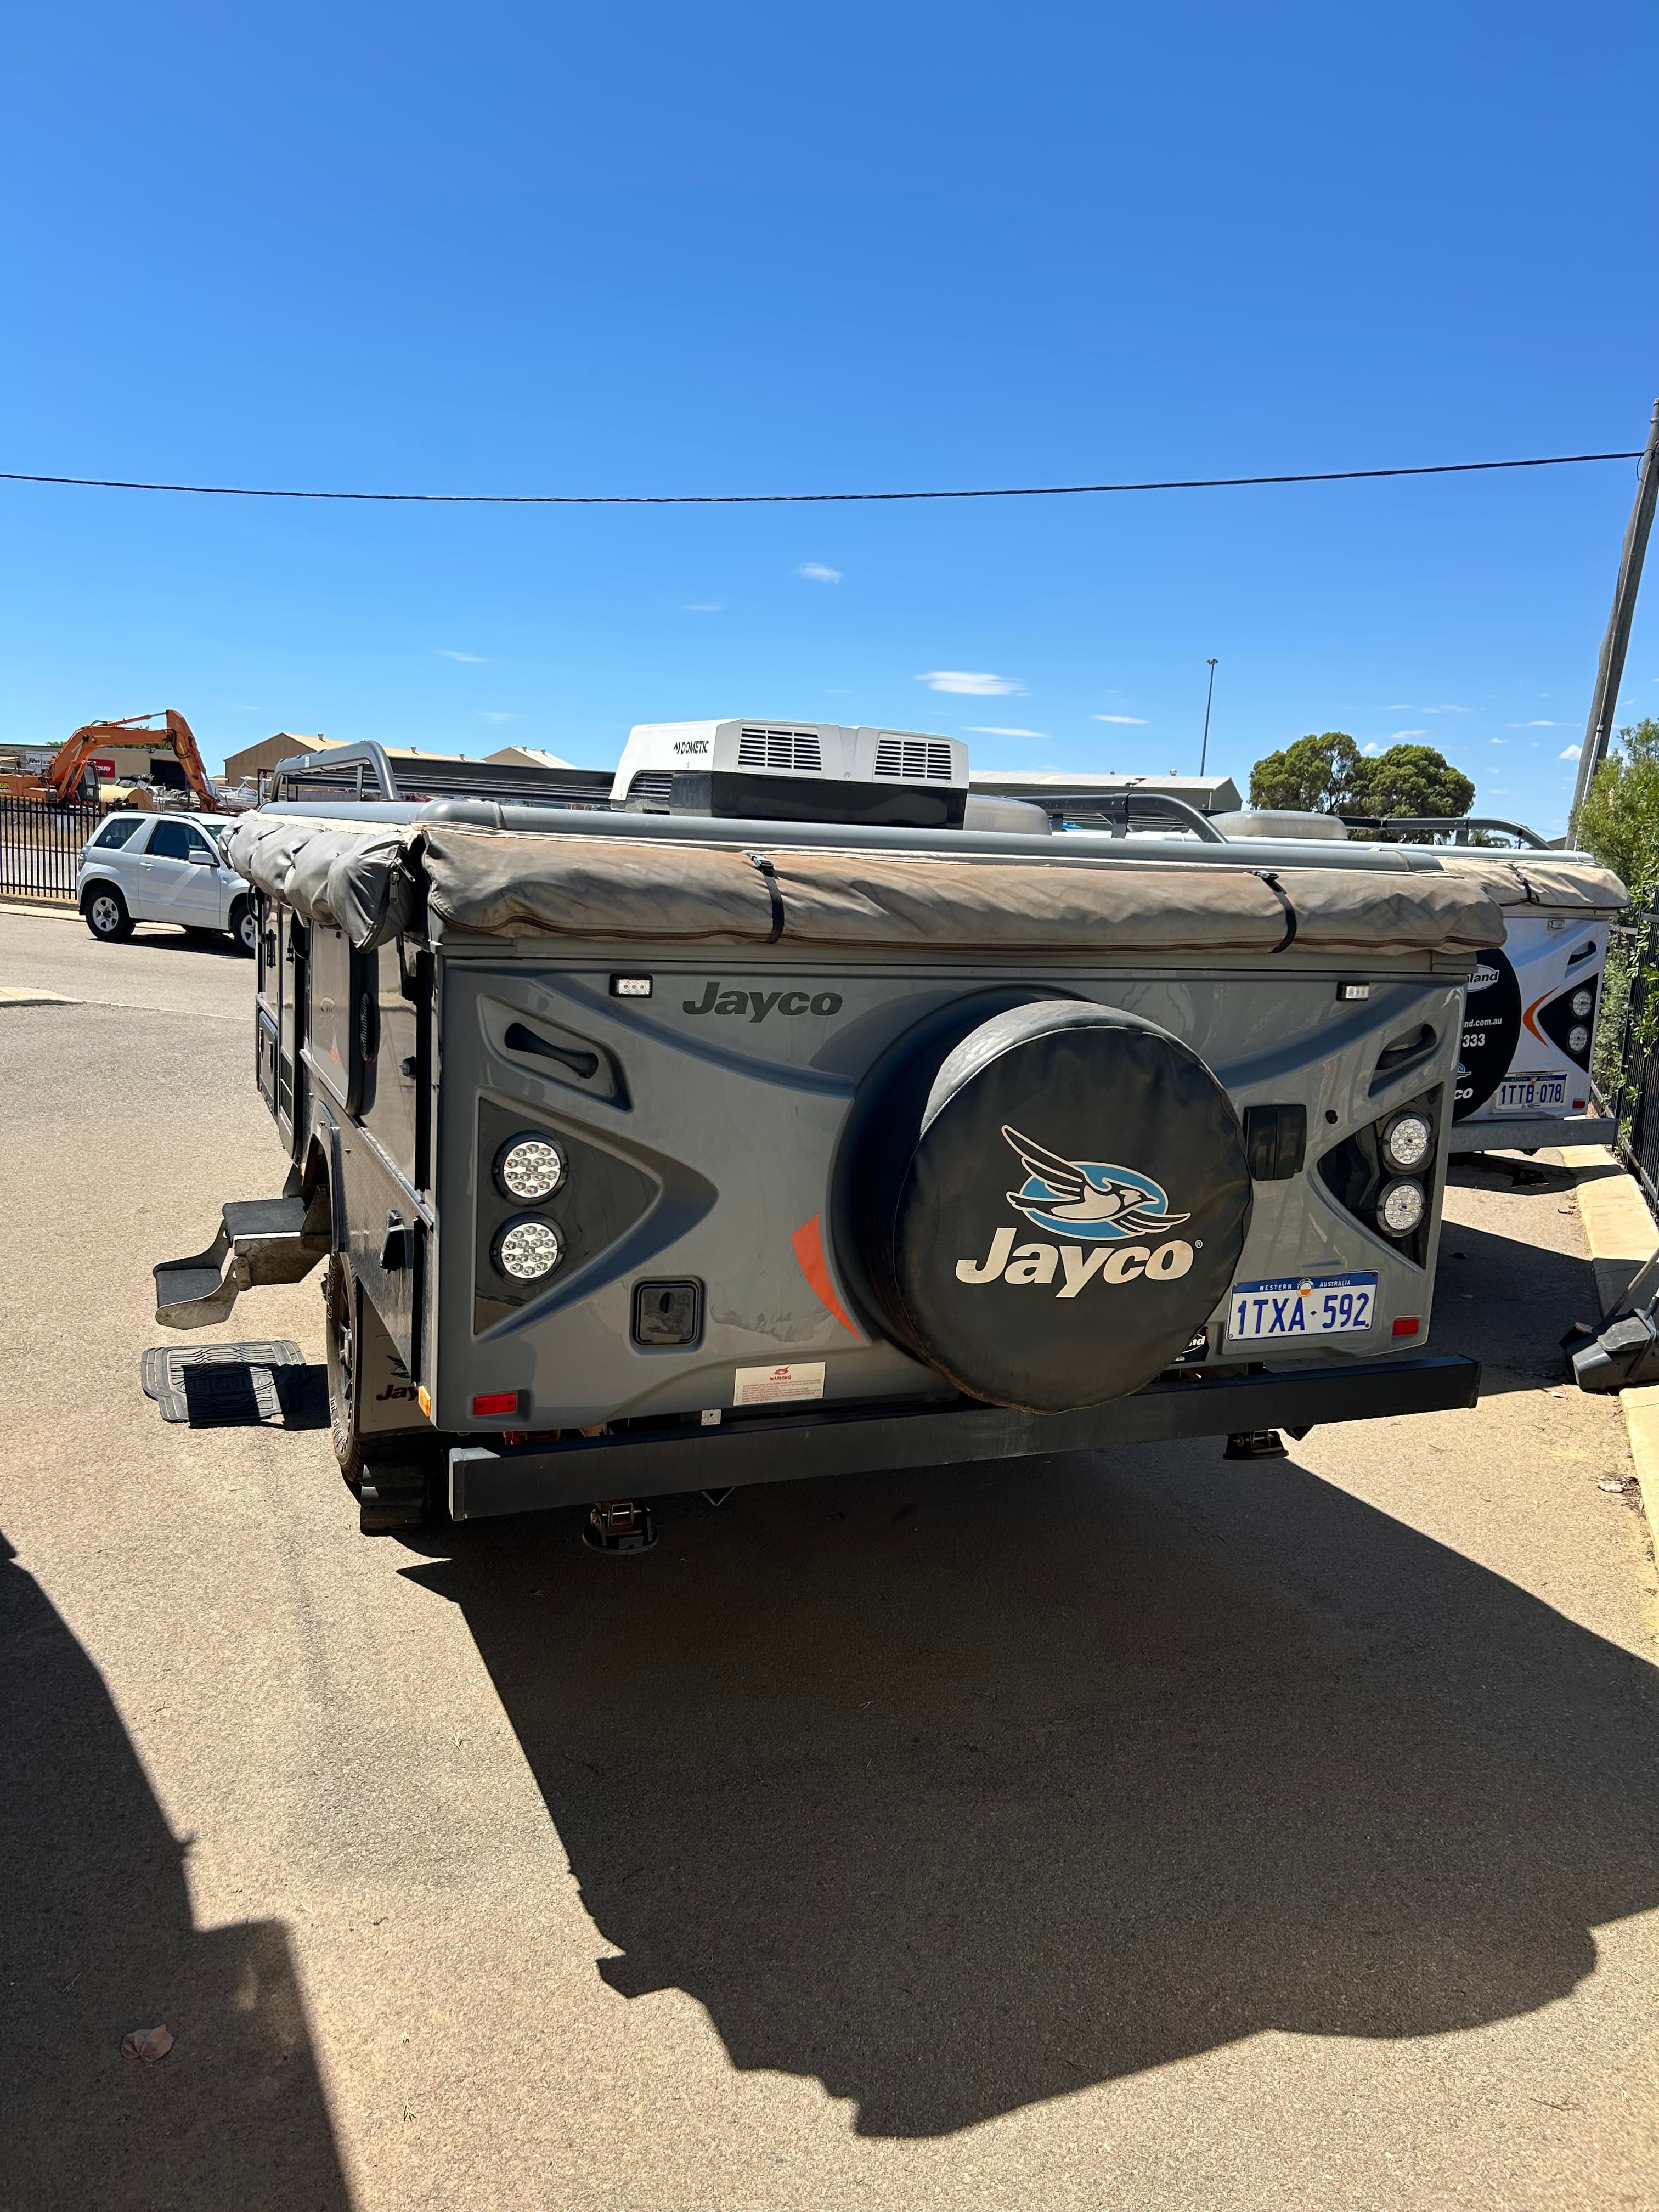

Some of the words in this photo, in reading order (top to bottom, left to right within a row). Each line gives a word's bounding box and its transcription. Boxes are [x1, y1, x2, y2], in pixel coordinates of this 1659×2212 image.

[681, 740, 709, 754] DOMETIC
[682, 981, 843, 1023] Jayco
[1462, 1034, 1485, 1047] 333
